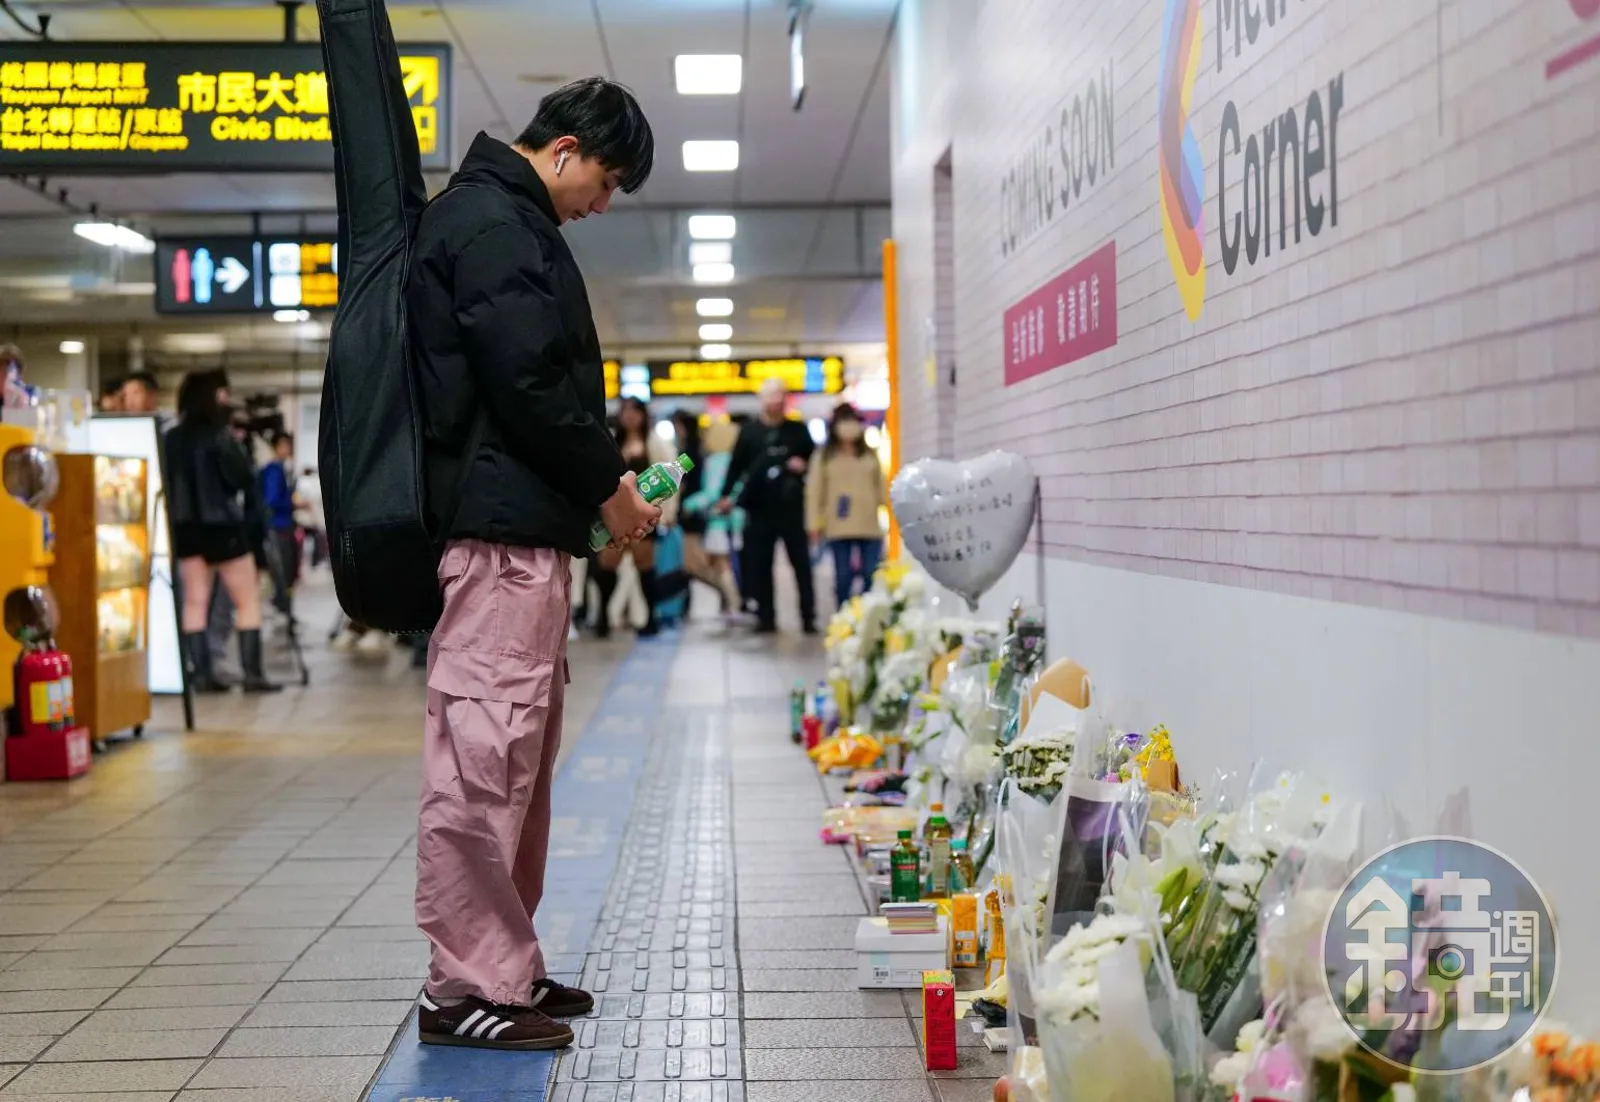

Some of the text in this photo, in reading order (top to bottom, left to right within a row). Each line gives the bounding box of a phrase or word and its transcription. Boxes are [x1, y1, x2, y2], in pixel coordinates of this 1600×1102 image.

[211, 116, 271, 141] Civic
[1060, 57, 1115, 210] SOON
[1218, 71, 1344, 276] Corner
